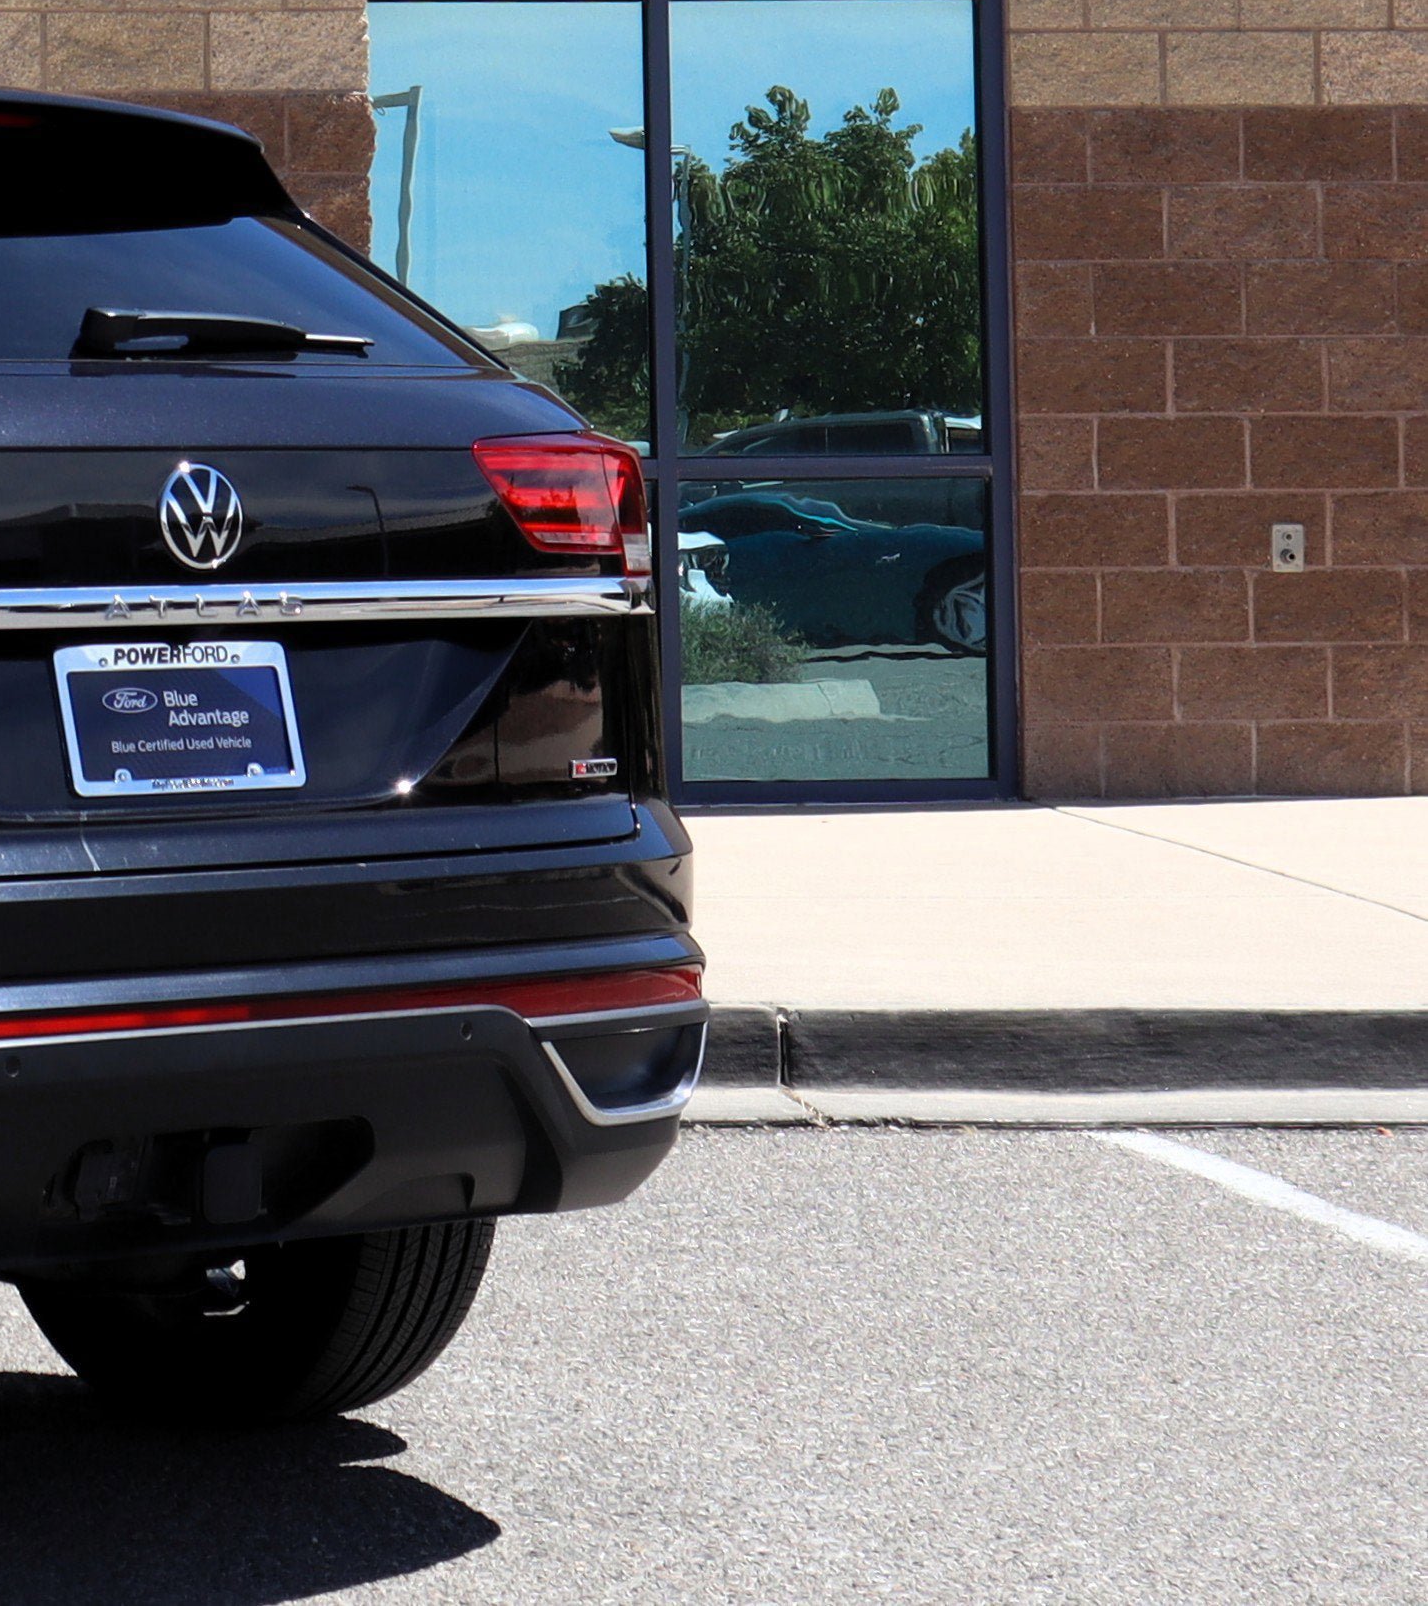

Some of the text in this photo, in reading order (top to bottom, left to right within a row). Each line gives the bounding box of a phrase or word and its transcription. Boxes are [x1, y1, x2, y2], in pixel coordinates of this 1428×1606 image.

[106, 591, 303, 620] ATLAS
[113, 691, 198, 709] Ford Blue
[168, 709, 249, 727] Advantage
[111, 736, 252, 753] Blue Certified Used Vehicle
